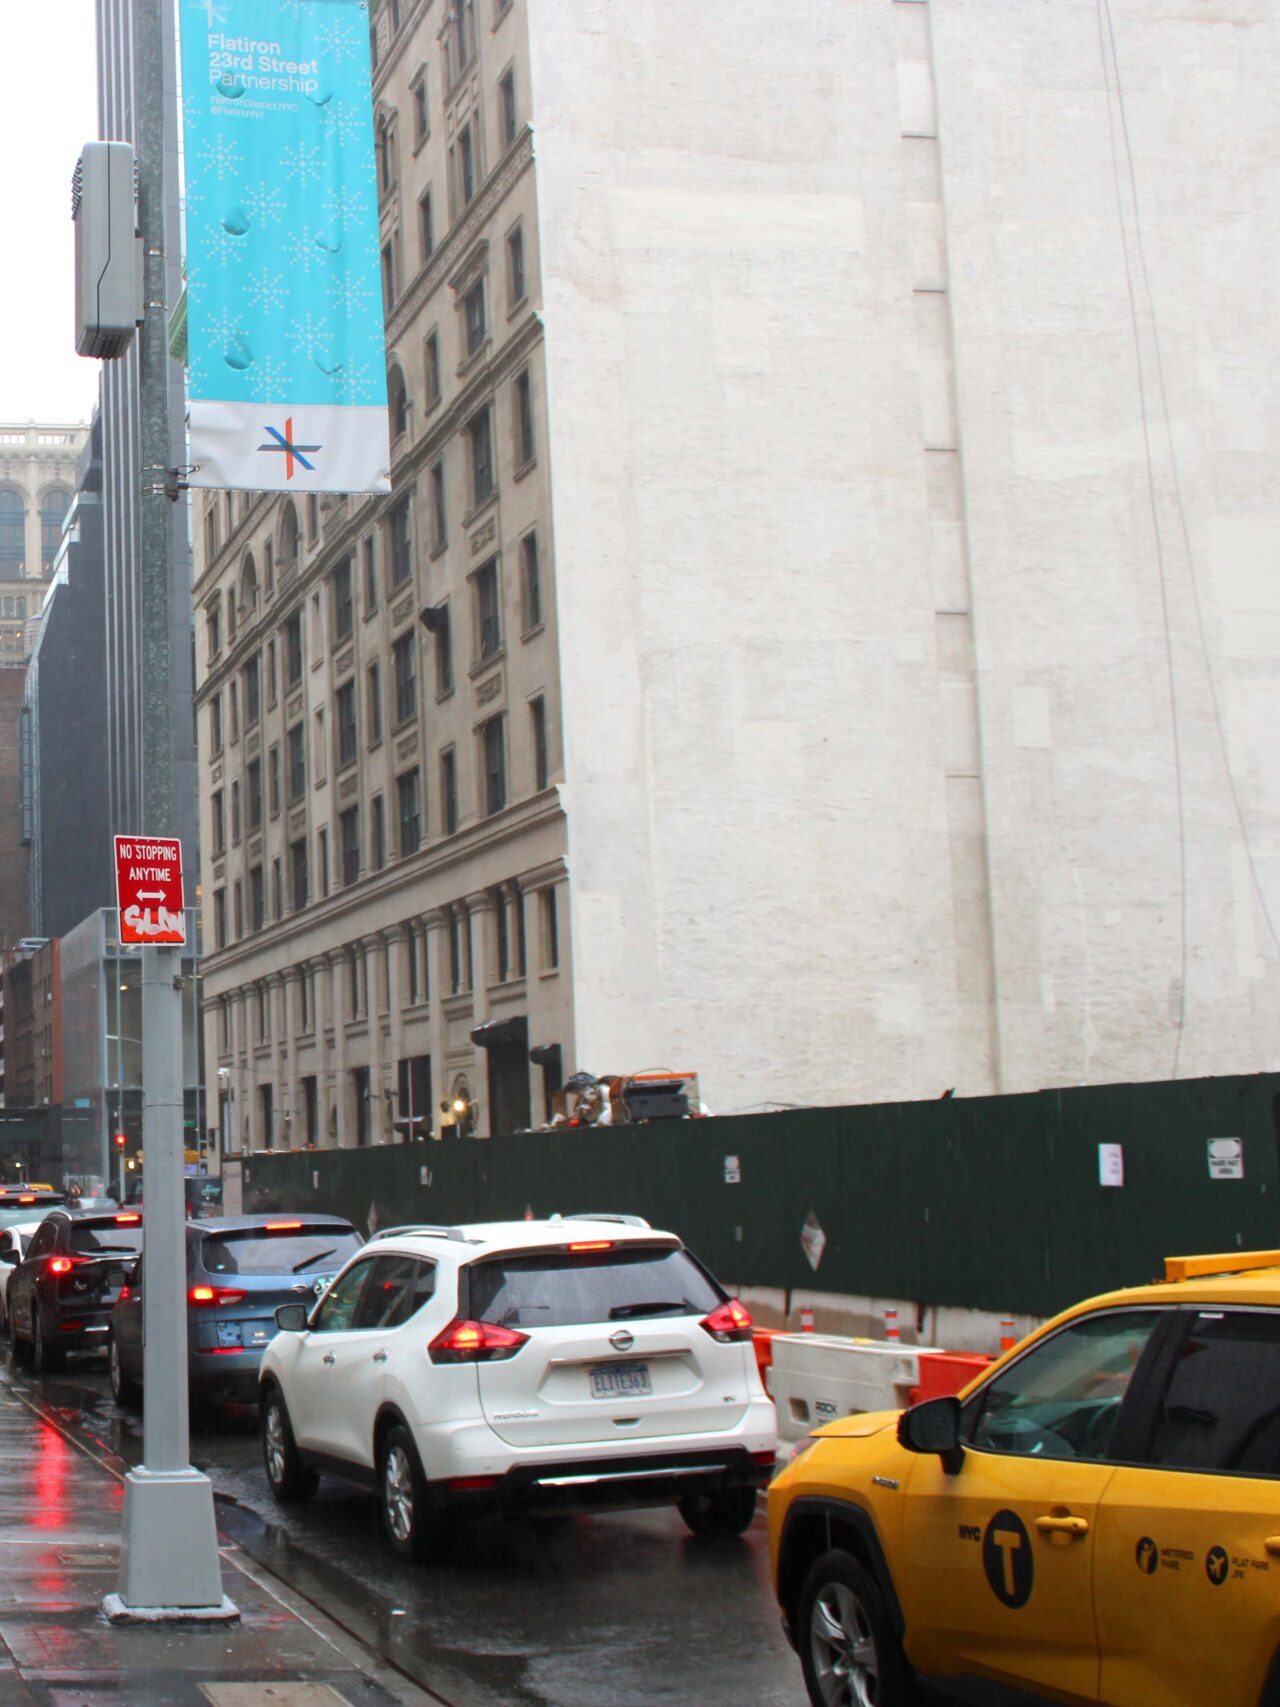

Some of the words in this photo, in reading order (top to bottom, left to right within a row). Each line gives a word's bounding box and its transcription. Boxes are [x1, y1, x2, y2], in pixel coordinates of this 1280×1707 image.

[208, 33, 281, 55] Flatiron
[209, 51, 254, 70] 23rd
[258, 55, 319, 75] Street
[209, 69, 319, 96] Partnership
[120, 844, 132, 859] NO
[135, 845, 177, 861] STOPPING
[129, 867, 171, 882] ANYTIME
[958, 1524, 981, 1542] NYC
[993, 1529, 1022, 1595] T
